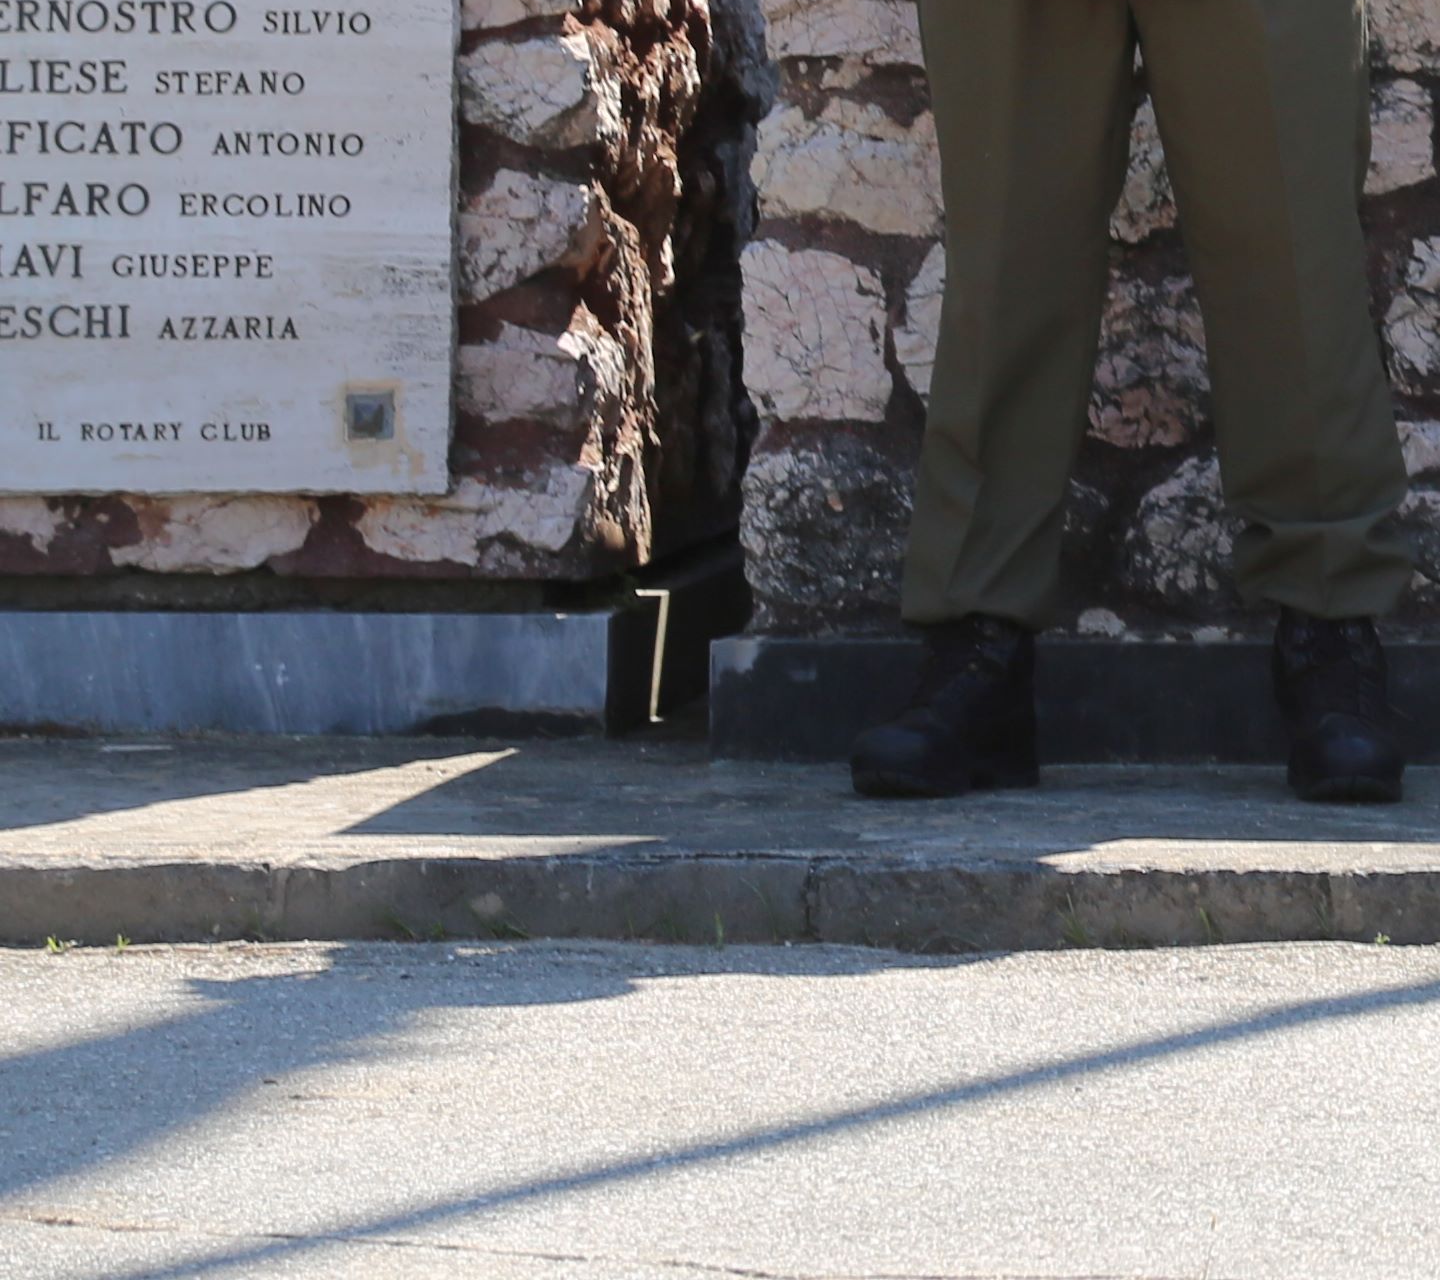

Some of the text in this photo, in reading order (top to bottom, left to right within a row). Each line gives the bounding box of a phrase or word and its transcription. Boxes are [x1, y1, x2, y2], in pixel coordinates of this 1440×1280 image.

[263, 10, 372, 35] SILVIO
[0, 59, 305, 96] LIESE STEFANO
[0, 120, 364, 157] FICATO ANTONIO
[179, 193, 351, 218] ERCOLINO
[0, 244, 273, 279] AVI GIUSEPPE
[158, 316, 299, 340] AZZARIA
[37, 421, 271, 442] IL ROTARY CLUB
